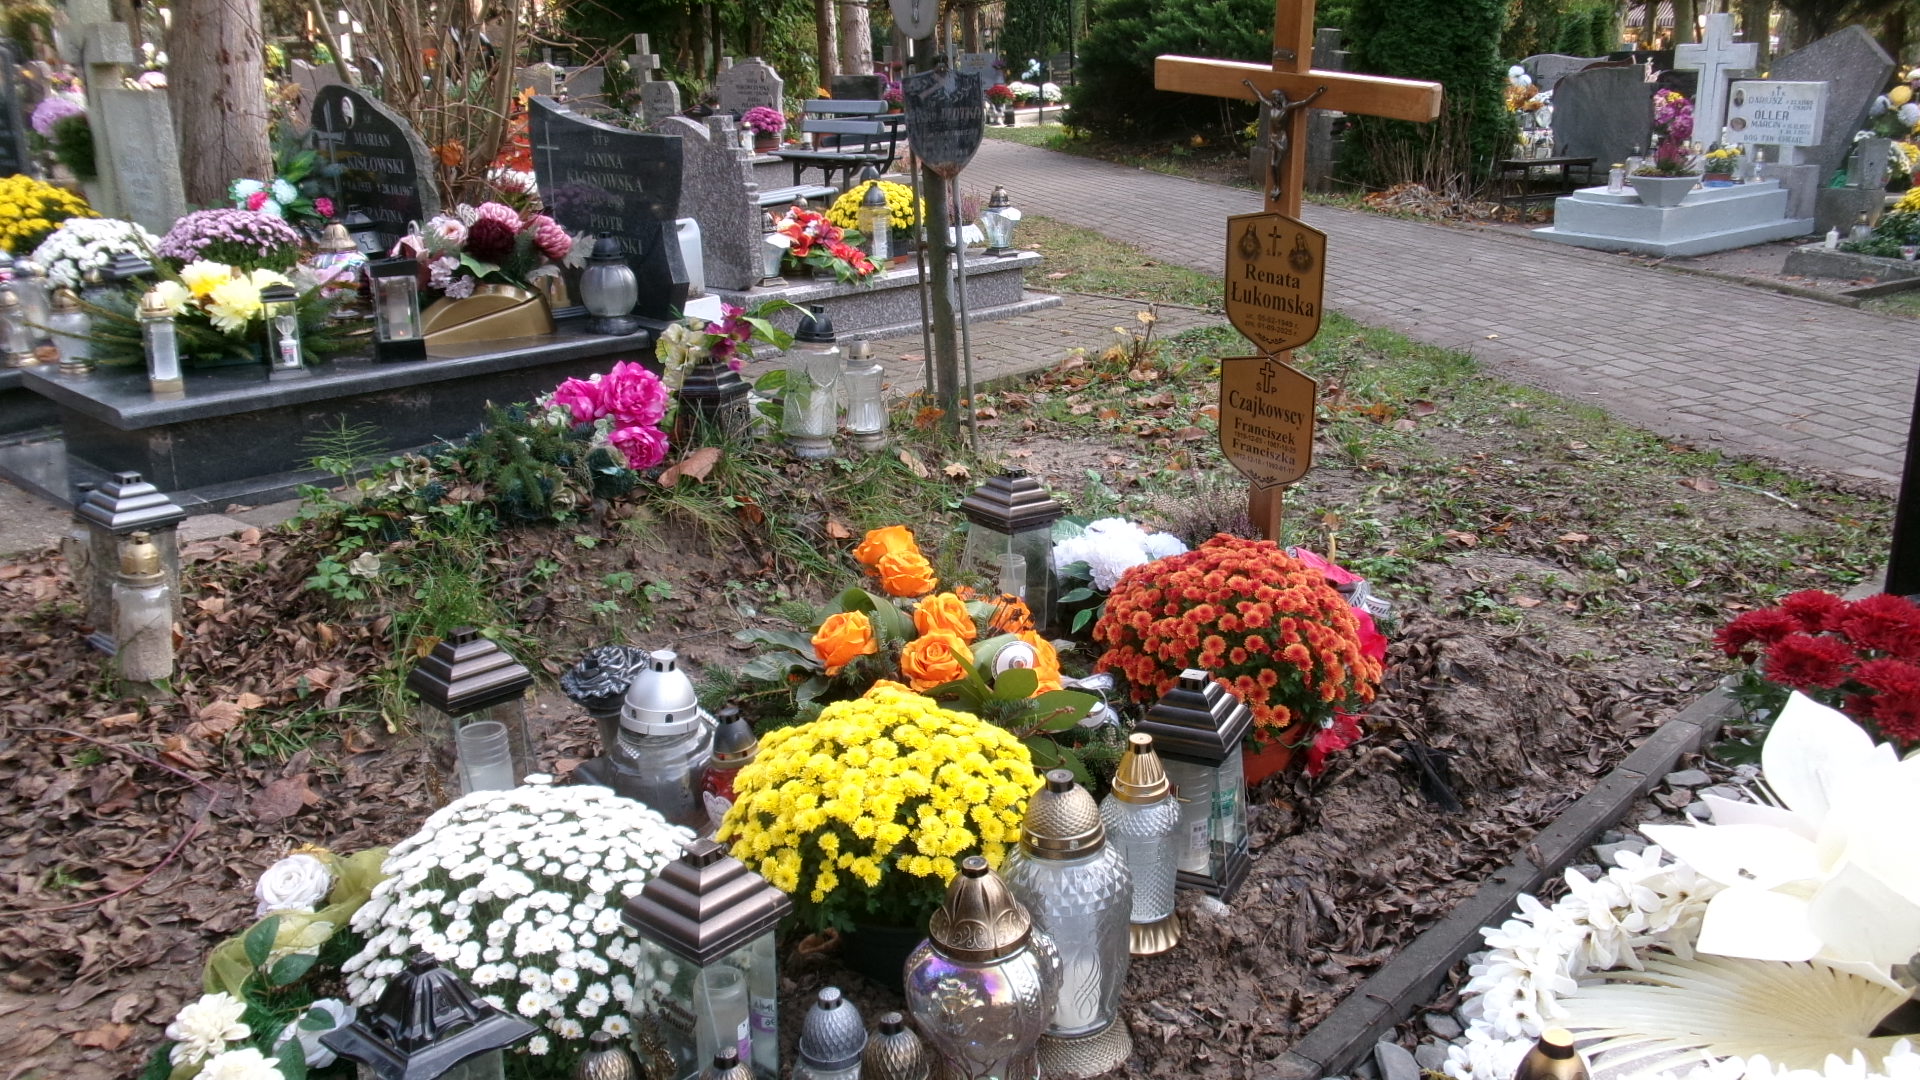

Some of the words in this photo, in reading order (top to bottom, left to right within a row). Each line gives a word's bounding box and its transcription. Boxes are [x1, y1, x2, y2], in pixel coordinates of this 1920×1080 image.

[1754, 110, 1790, 120] OLLER
[353, 131, 390, 147] MARIAN
[584, 153, 623, 169] JANINA
[567, 170, 644, 193] KŁOSOWSKA
[590, 213, 624, 231] PIOTR
[1245, 263, 1300, 289] Renata
[1231, 281, 1314, 318] Łukomska
[1229, 389, 1305, 427] Czajkowscy
[1234, 417, 1296, 446] Franciszek
[1232, 438, 1296, 466] Franciszka
